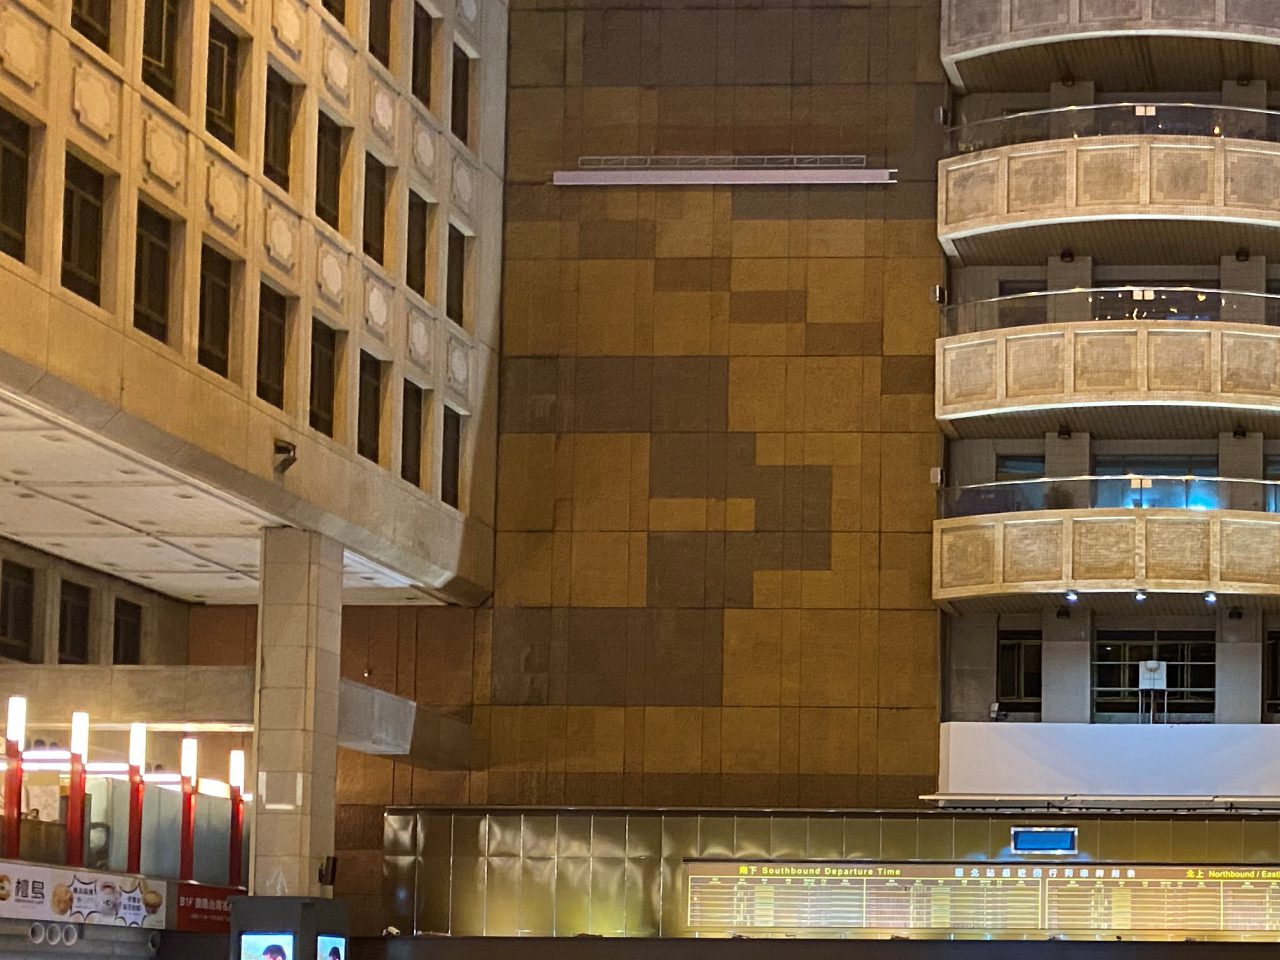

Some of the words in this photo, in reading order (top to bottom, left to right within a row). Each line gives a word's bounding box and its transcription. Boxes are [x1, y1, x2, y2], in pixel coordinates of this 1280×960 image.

[762, 867, 821, 876] Southbound
[824, 867, 874, 877] Departure
[877, 867, 901, 876] Time
[1208, 870, 1255, 878] Northbound
